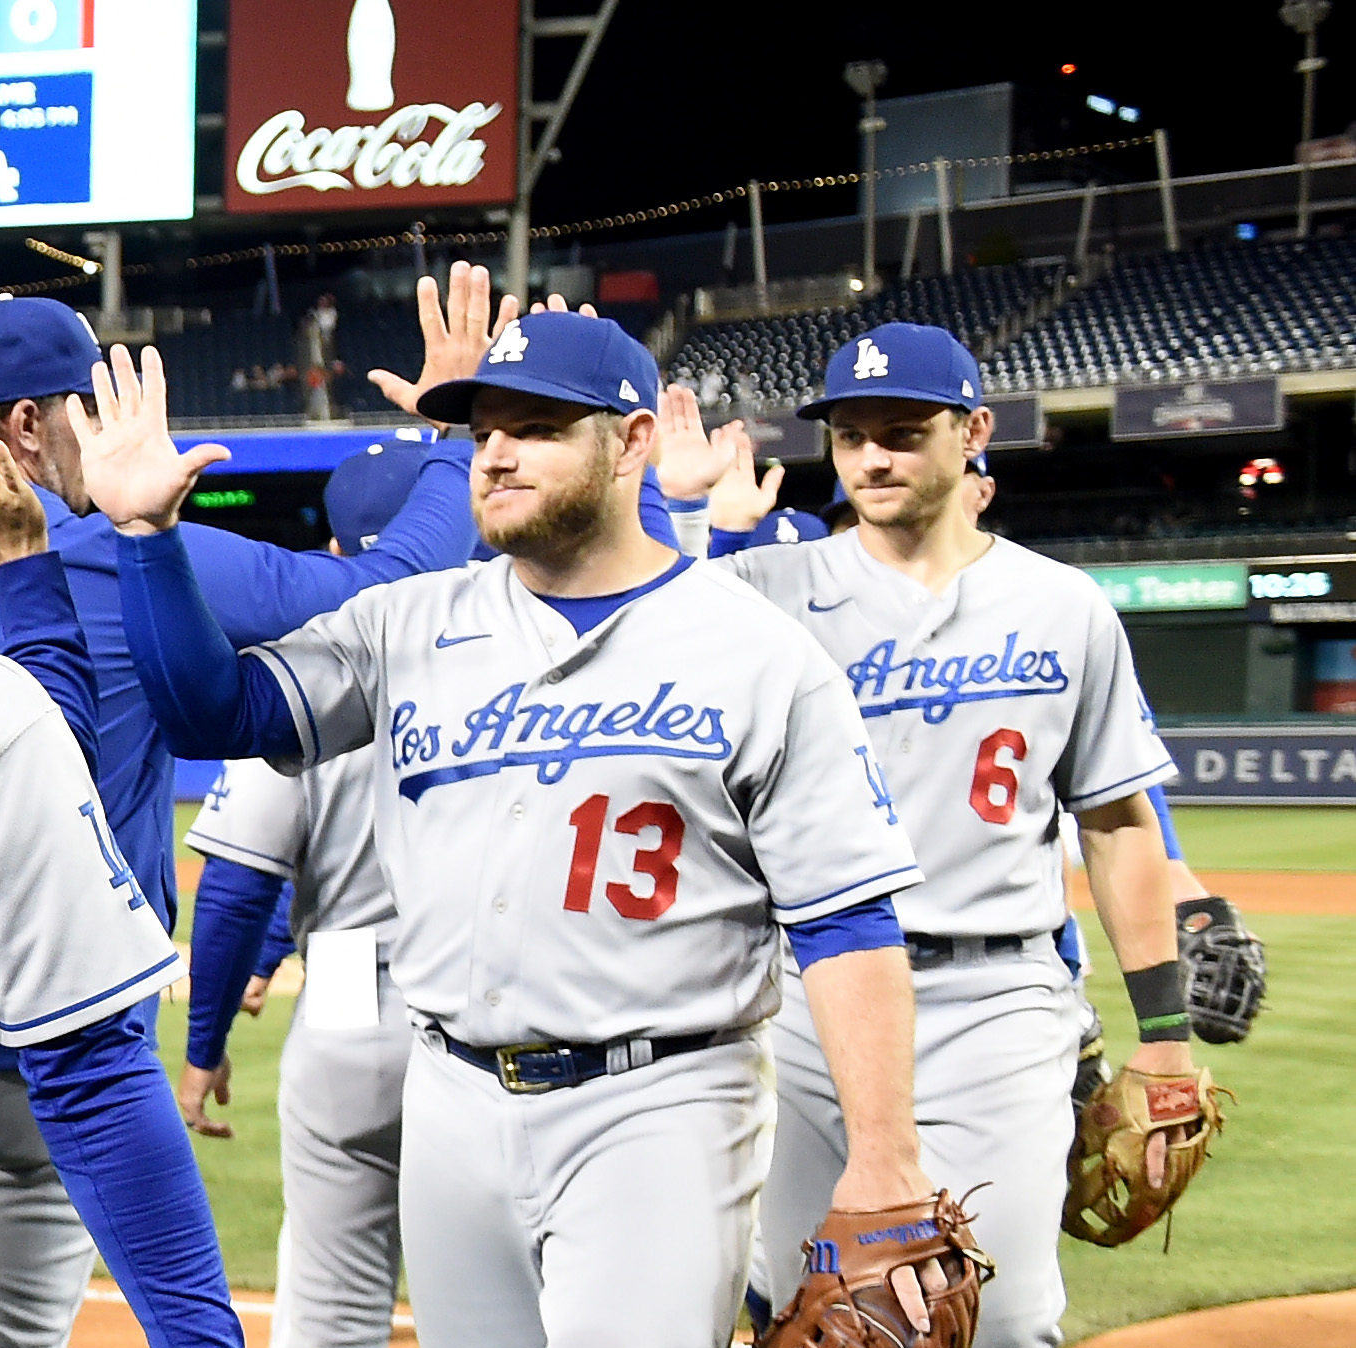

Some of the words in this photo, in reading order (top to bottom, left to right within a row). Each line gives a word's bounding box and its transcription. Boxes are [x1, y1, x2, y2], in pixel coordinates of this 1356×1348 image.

[9, 0, 57, 44] 0
[853, 338, 889, 380] LA
[847, 631, 1069, 725] Angeles
[389, 700, 441, 771] Los
[452, 683, 732, 784] Angeles
[969, 728, 1027, 825] 6
[1195, 748, 1356, 784] DELTA
[564, 794, 686, 921] 13
